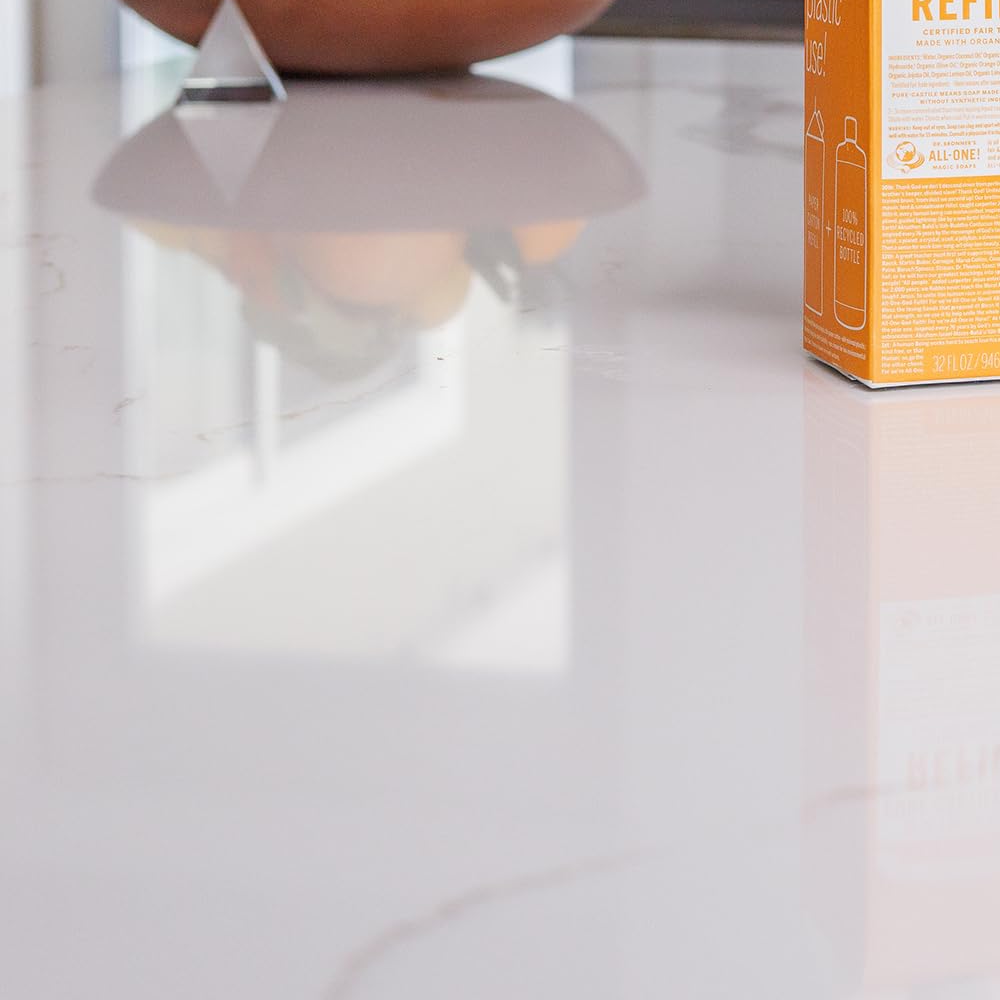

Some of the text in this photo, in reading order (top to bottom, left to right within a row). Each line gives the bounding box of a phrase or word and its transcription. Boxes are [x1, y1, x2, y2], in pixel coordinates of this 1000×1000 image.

[923, 28, 971, 36] CERTIFIED
[974, 27, 994, 35] FAIR
[916, 39, 942, 47] MADE
[806, 32, 827, 78] use!
[928, 148, 980, 162] ALL-ONE!
[837, 225, 864, 247] RECYCLED
[840, 245, 860, 265] BOTTLE
[933, 355, 945, 373] 32
